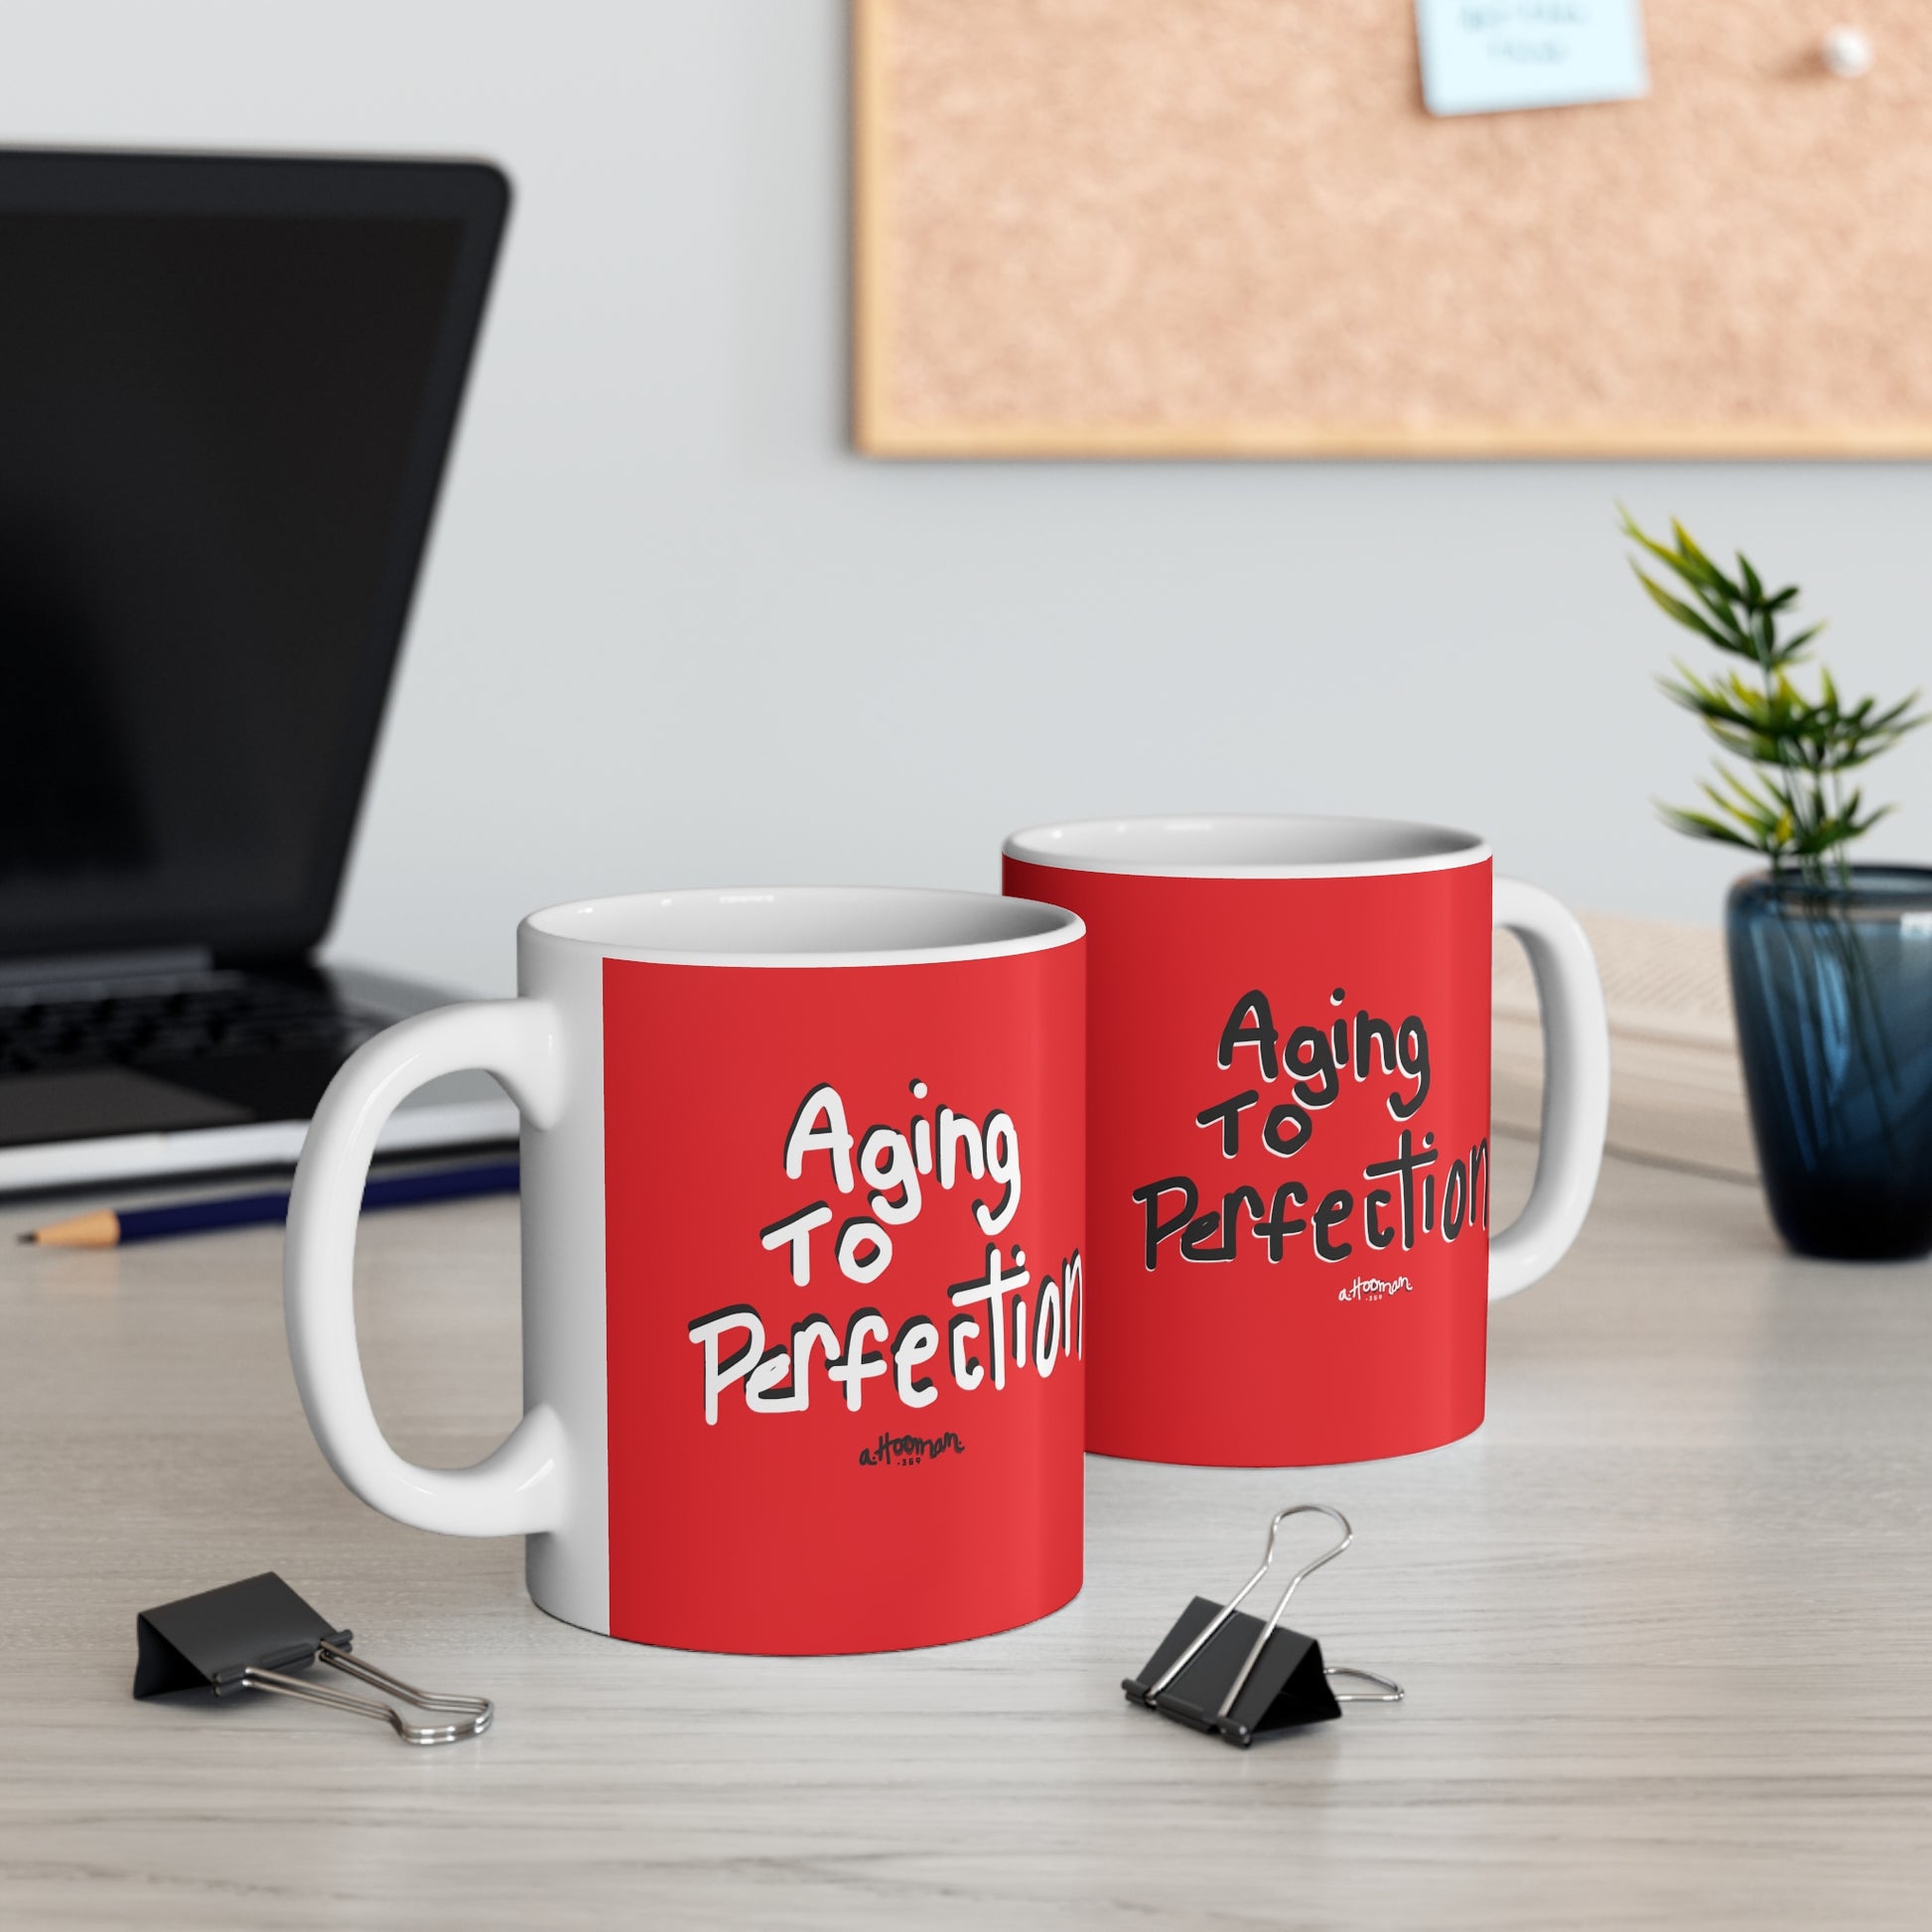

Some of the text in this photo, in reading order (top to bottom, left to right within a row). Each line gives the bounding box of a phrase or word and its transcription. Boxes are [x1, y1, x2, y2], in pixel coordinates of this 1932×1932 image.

[1217, 988, 1431, 1121] Aging
[783, 1078, 1022, 1235] Aging
[1133, 1129, 1488, 1272] Perfection
[688, 1242, 1082, 1426] Perfection
